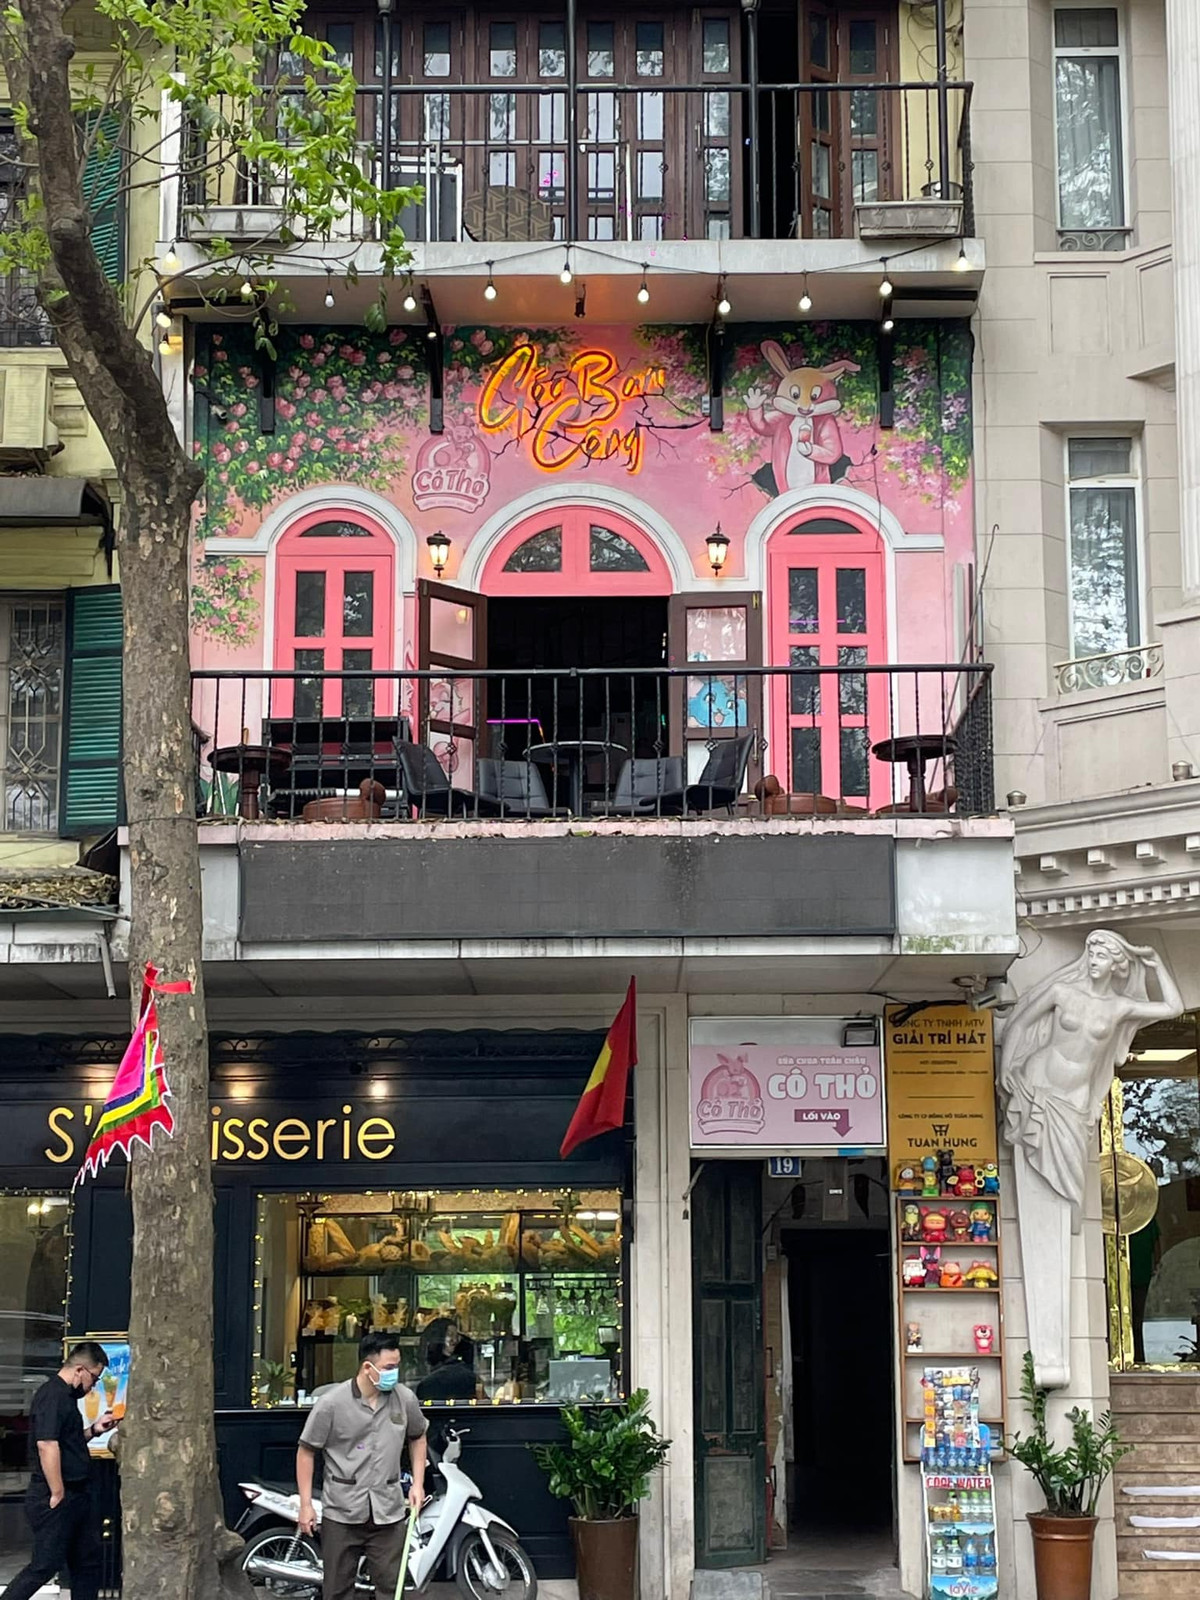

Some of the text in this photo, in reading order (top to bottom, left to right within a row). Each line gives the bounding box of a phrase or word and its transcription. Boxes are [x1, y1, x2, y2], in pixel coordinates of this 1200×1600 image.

[893, 1029, 923, 1044] GIẢI
[928, 1029, 951, 1044] TRÍ
[767, 1066, 877, 1100] CÔ THỎ
[820, 1111, 841, 1120] VÀO
[907, 1138, 977, 1147] TUAN HUNG
[775, 1157, 793, 1174] 19
